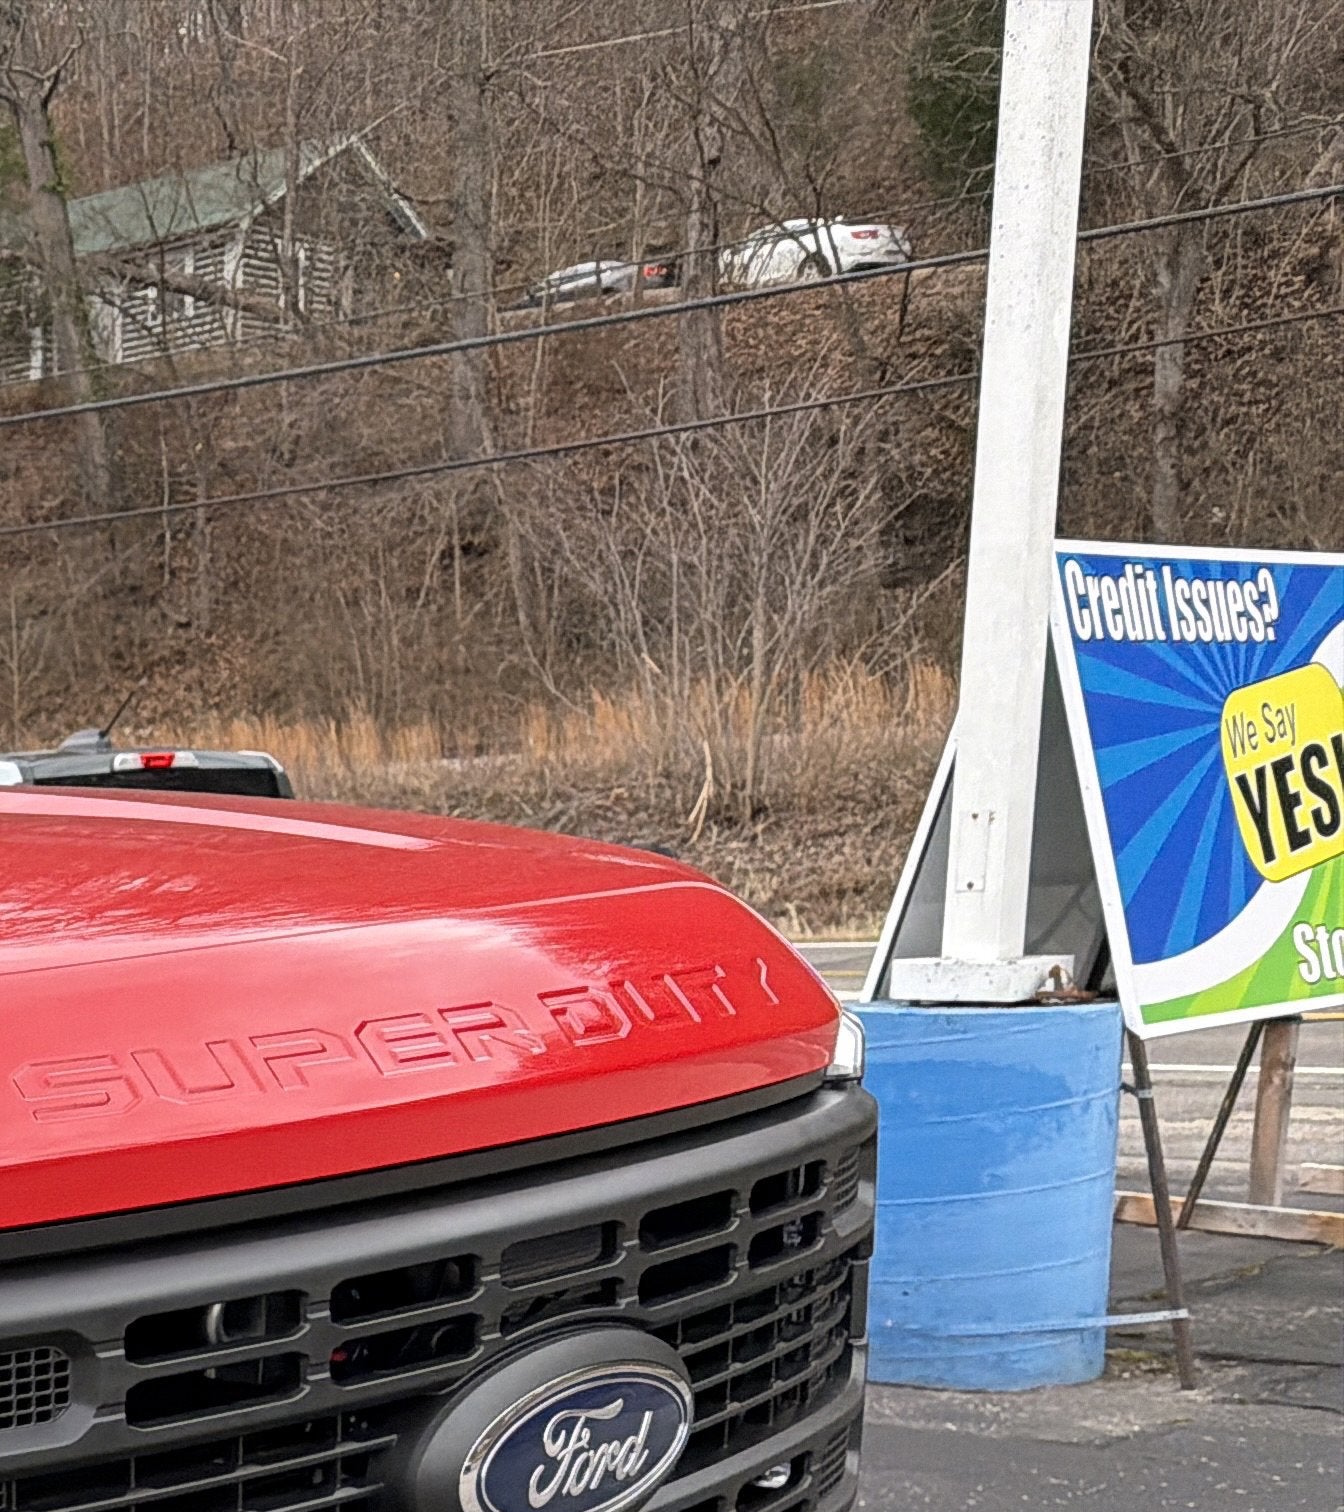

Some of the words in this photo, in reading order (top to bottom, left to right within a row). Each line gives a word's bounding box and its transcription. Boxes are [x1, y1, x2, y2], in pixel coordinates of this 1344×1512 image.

[1064, 559, 1167, 641] Credit
[1161, 564, 1280, 642] Issues?
[1224, 711, 1259, 758] We
[1260, 702, 1297, 747] Say
[12, 1001, 547, 1124] SUPER
[536, 956, 781, 1048] DUTY
[527, 1397, 654, 1509] Ford
